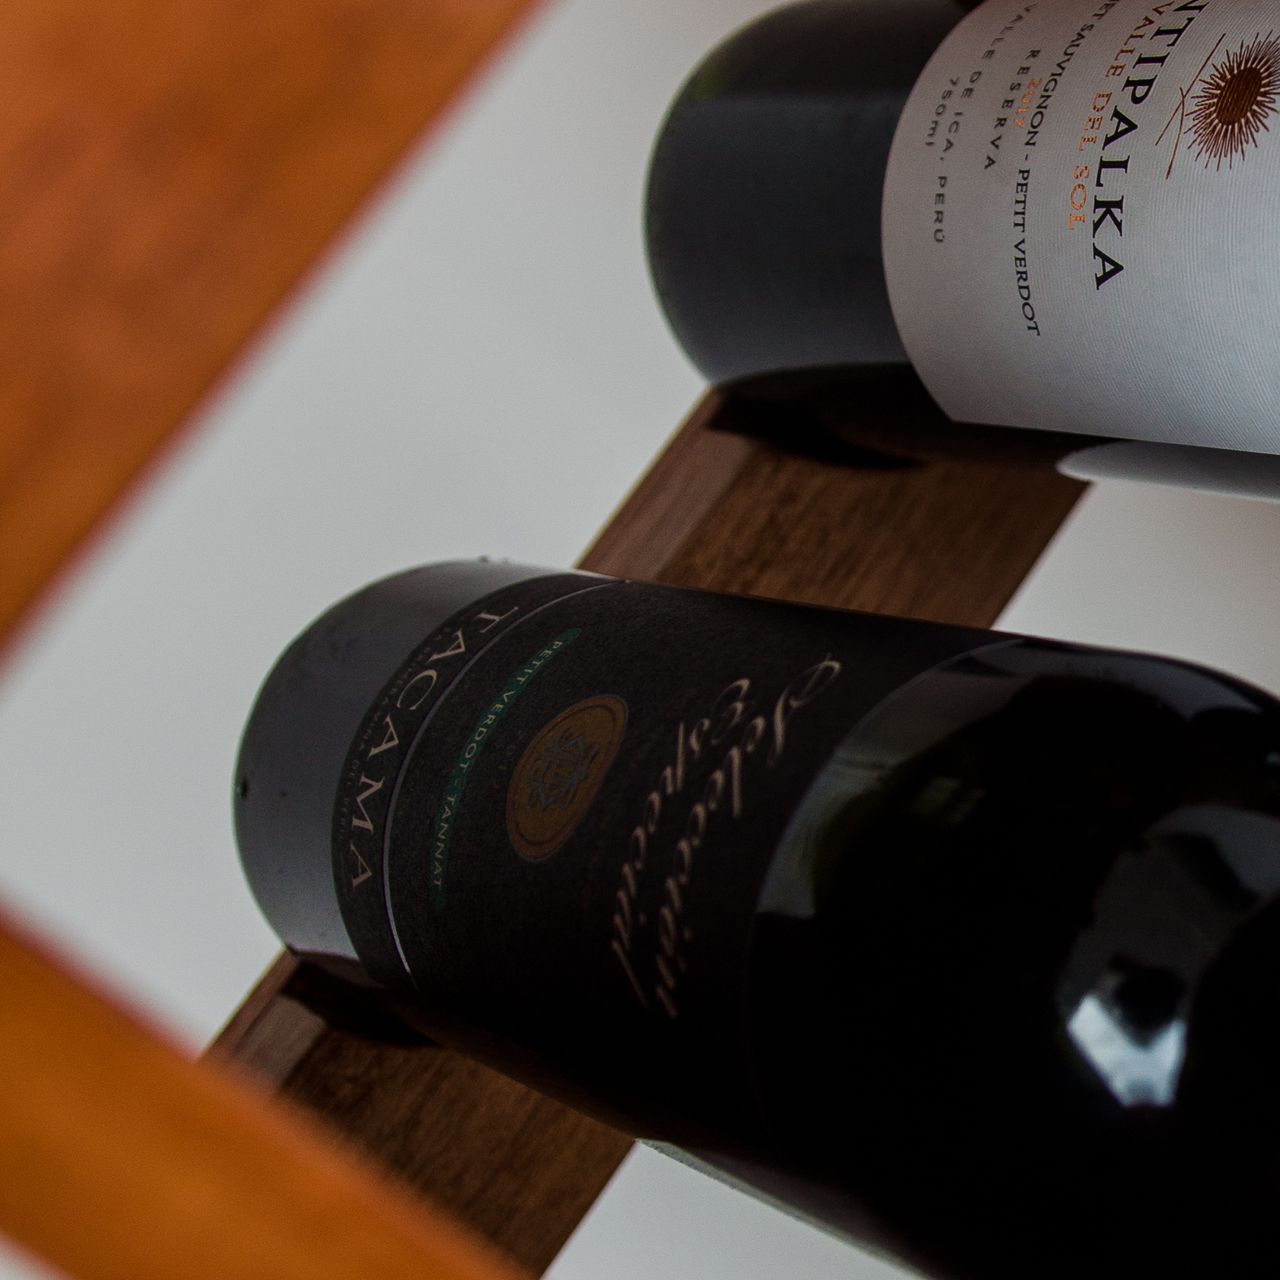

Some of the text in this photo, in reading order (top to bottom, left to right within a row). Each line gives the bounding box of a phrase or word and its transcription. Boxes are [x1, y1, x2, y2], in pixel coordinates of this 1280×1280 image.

[982, 2, 1039, 59] VALLE
[961, 71, 982, 99] DE
[984, 49, 1041, 170] RESERVA
[1025, 23, 1094, 147] SAUVIGNON
[1068, 0, 1175, 231] VALLE DEL SOL
[1013, 168, 1031, 232] PETIT
[1014, 238, 1041, 337] VERDOT
[515, 640, 564, 686] PETIT
[350, 605, 520, 888] TACAMA
[458, 689, 516, 772] VERDOT
[433, 793, 458, 889] TANNAT
